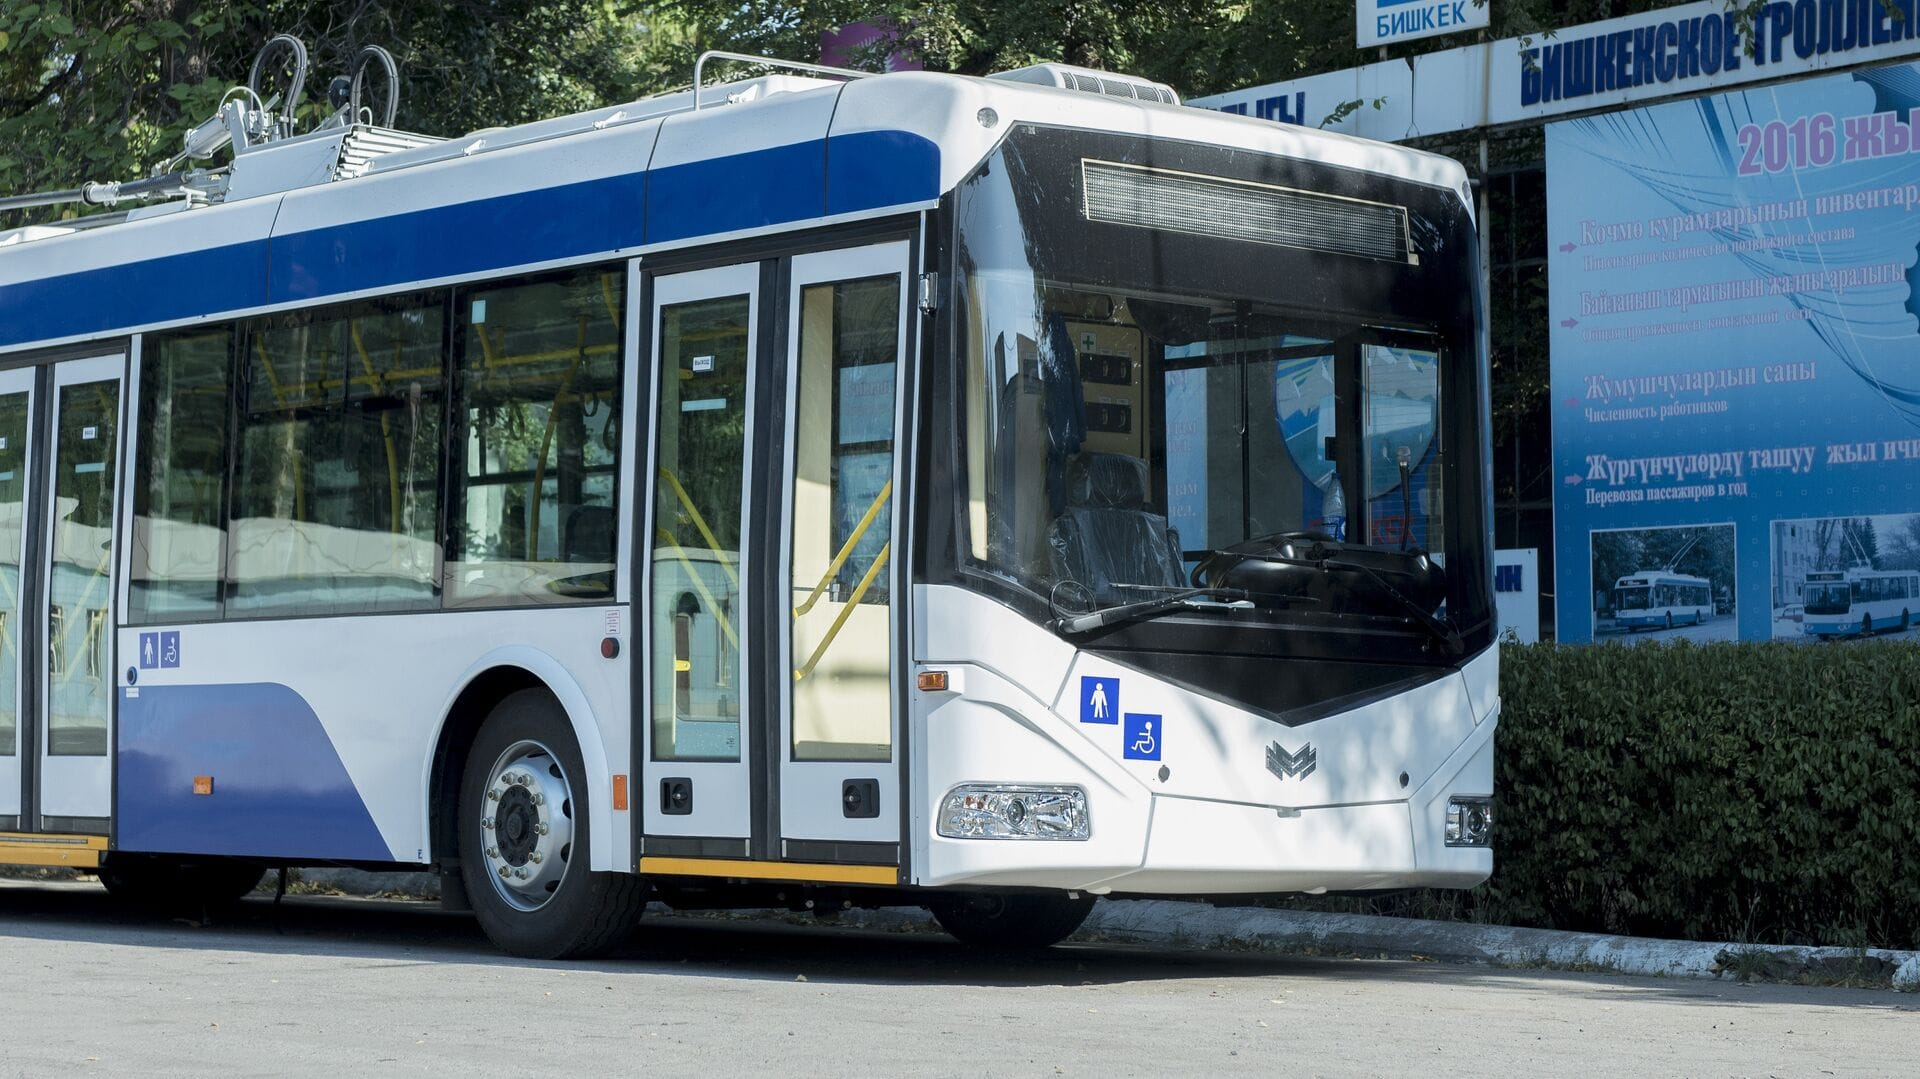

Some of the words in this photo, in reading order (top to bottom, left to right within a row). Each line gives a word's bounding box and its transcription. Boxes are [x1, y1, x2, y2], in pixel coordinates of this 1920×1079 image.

[1376, 1, 1466, 38] БИШКЕК
[1520, 11, 1741, 107] БИШКЕКСКОЕ
[1738, 112, 1837, 177] 2016
[1815, 183, 1920, 215] инвентар
[1807, 226, 1856, 245] состава
[1829, 263, 1906, 296] аралыгы
[1763, 360, 1817, 383] саны
[1584, 405, 1657, 423] Численность
[1660, 399, 1728, 421] работников
[1749, 446, 1816, 474] ташуу
[1826, 441, 1877, 464] жыл
[1585, 486, 1644, 508] Перевозка
[1647, 483, 1715, 502] пассажиров
[1718, 483, 1725, 496] в
[1728, 482, 1748, 497] год
